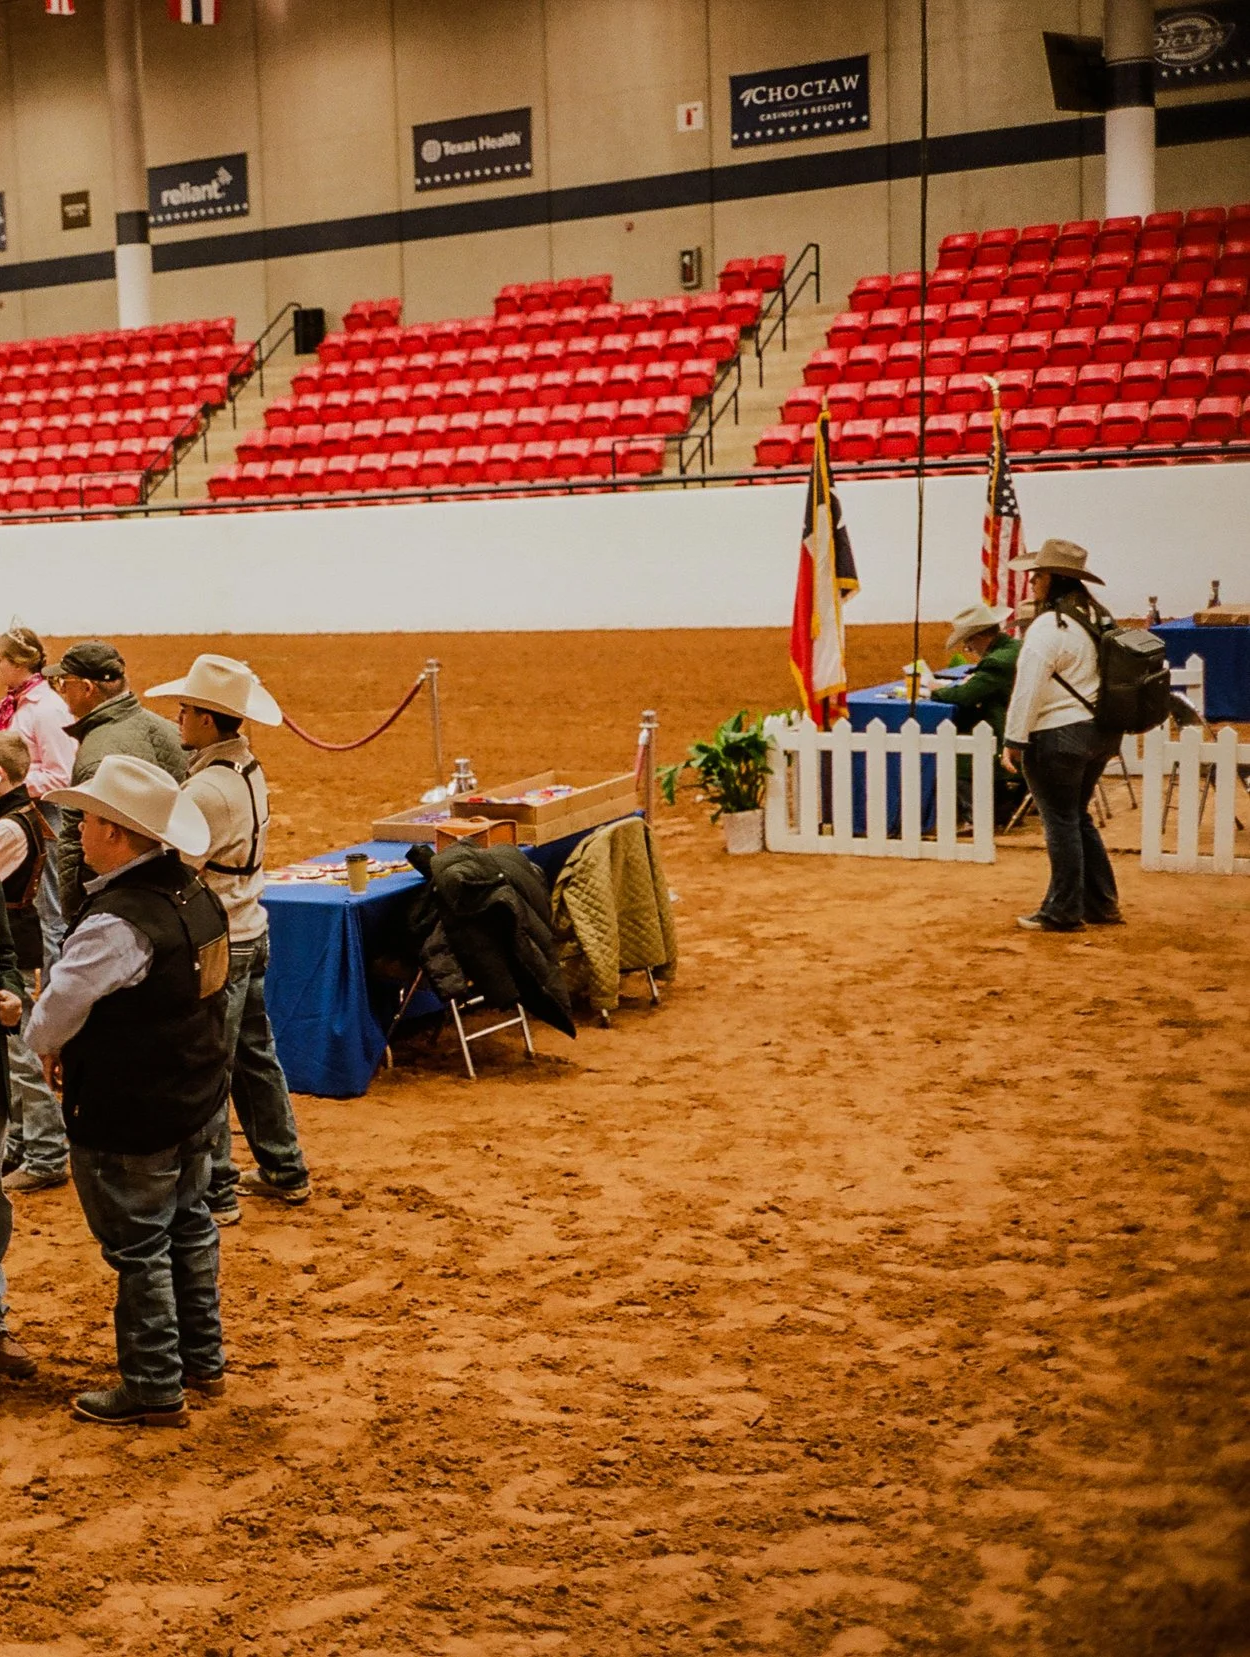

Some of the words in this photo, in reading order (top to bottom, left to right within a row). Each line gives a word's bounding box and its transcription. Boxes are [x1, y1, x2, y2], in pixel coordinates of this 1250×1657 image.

[751, 74, 861, 105] CHOCTAW
[759, 108, 800, 122] CASINOS
[802, 107, 809, 117] &
[810, 101, 853, 114] RESORTS
[442, 140, 477, 156] Texas
[477, 132, 520, 151] Health
[161, 179, 224, 207] reliant
